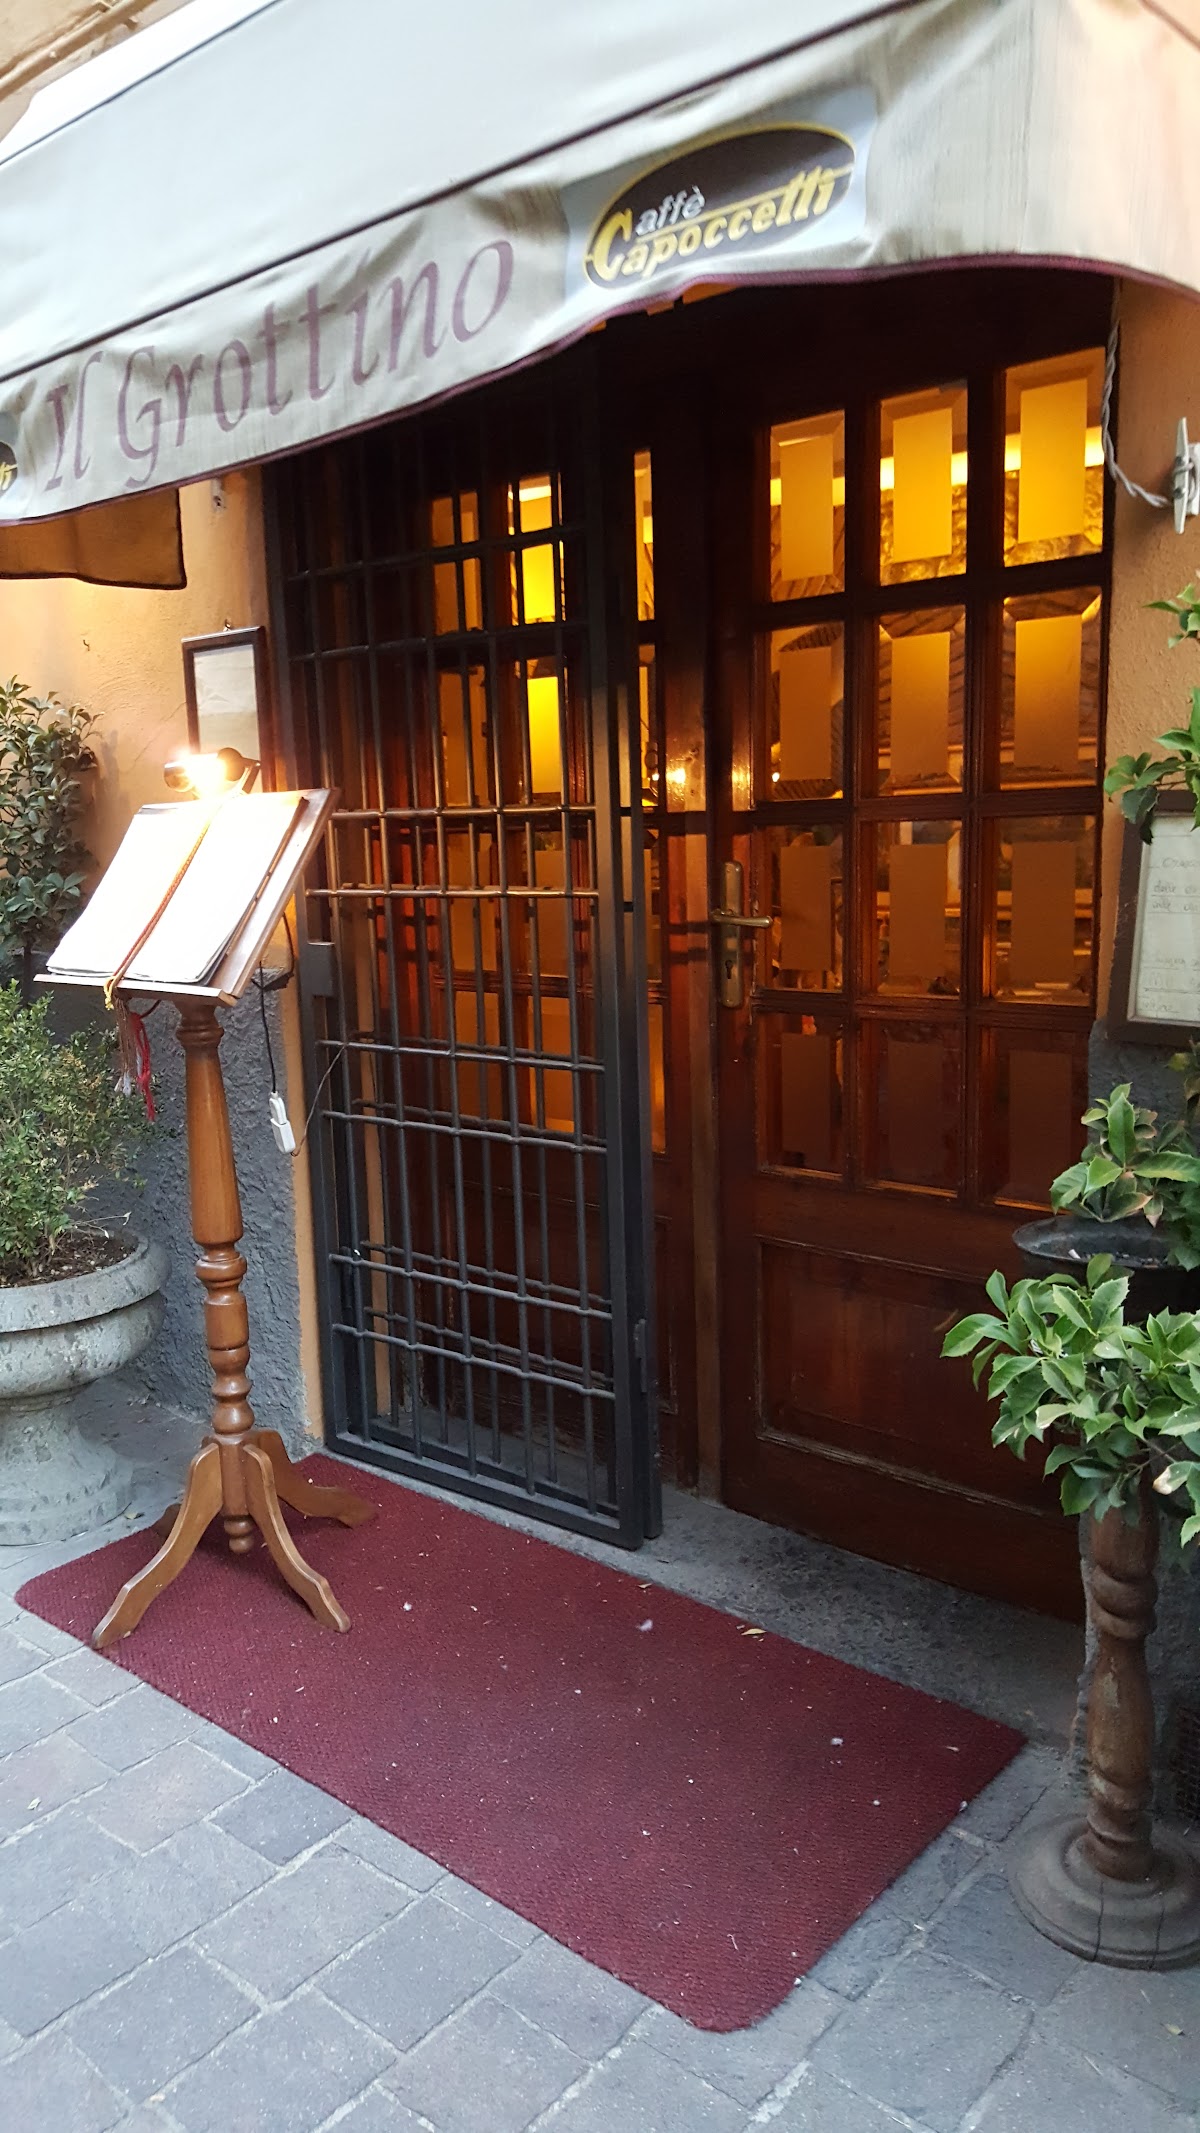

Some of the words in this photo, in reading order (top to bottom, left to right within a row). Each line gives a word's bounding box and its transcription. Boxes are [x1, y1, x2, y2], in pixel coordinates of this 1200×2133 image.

[593, 165, 837, 282] Capoccetti
[45, 350, 103, 491] Il
[116, 240, 515, 489] Grottino
